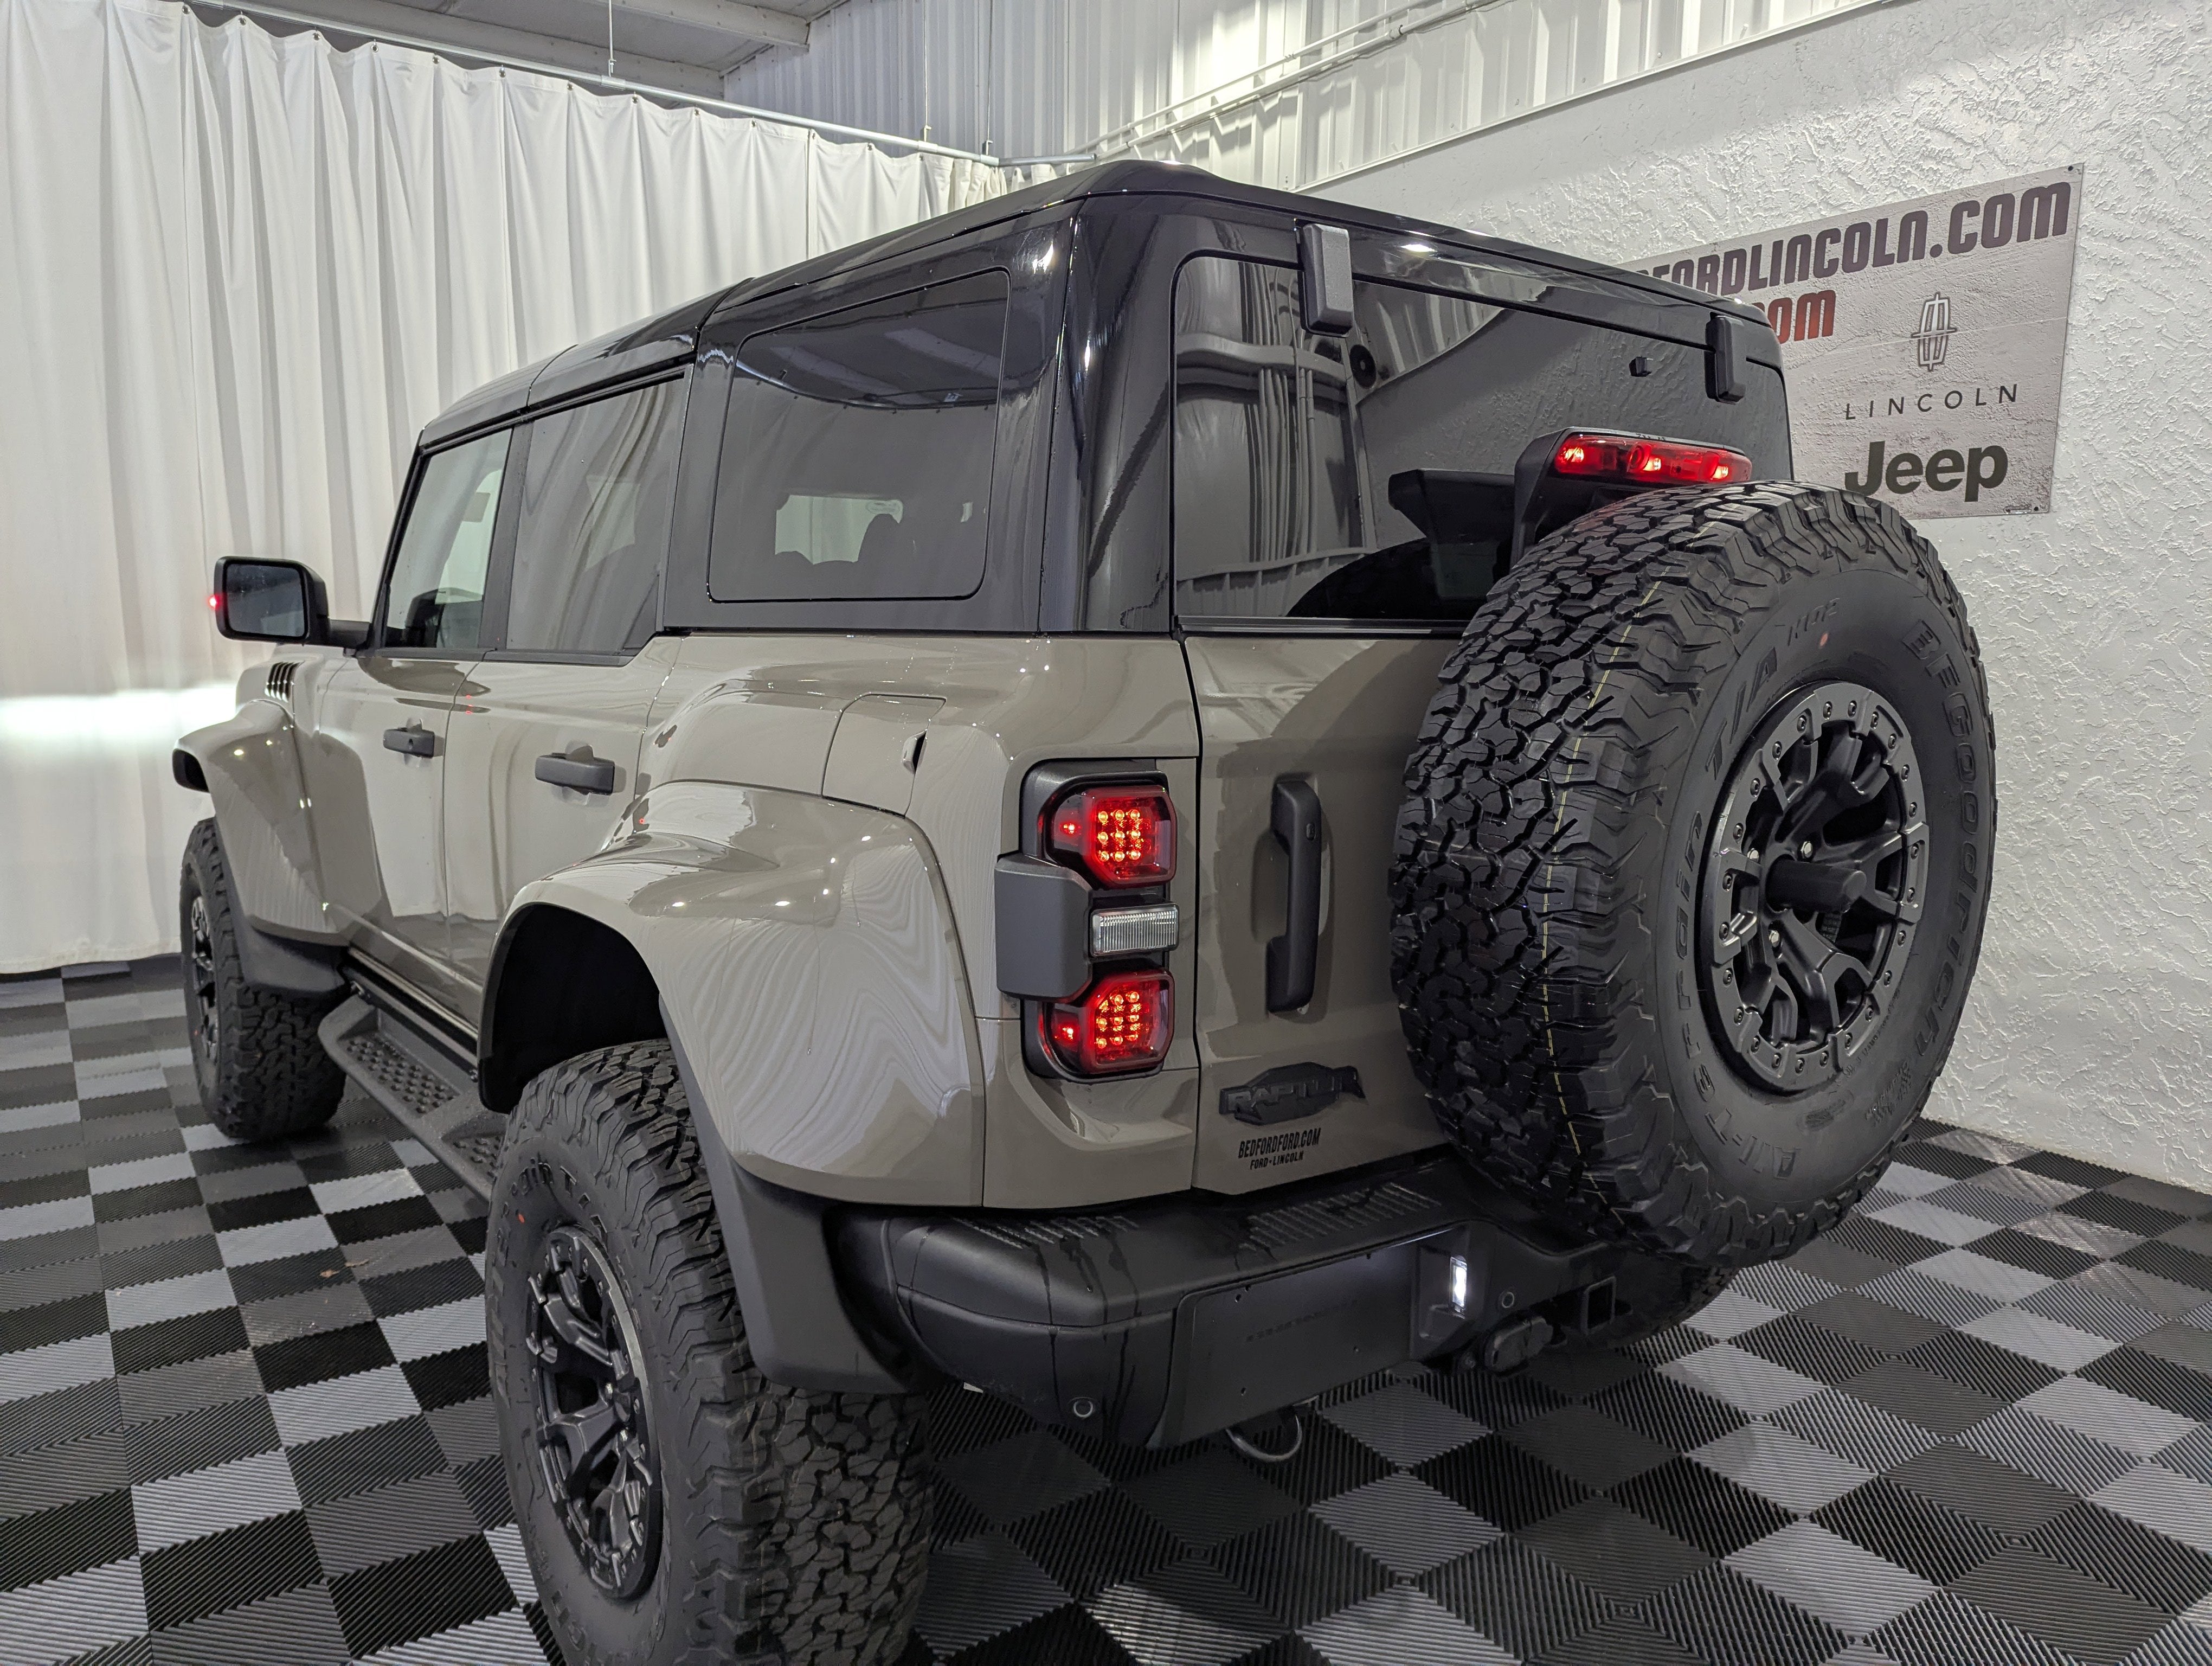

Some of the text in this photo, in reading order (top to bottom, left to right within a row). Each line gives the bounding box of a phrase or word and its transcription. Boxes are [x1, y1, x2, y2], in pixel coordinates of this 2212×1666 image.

[1753, 279, 1836, 345] OM
[1845, 383, 2018, 420] LINCOLN
[1844, 440, 2008, 502] Jeep
[1238, 1127, 1321, 1158] BEDFORDFORD.COM
